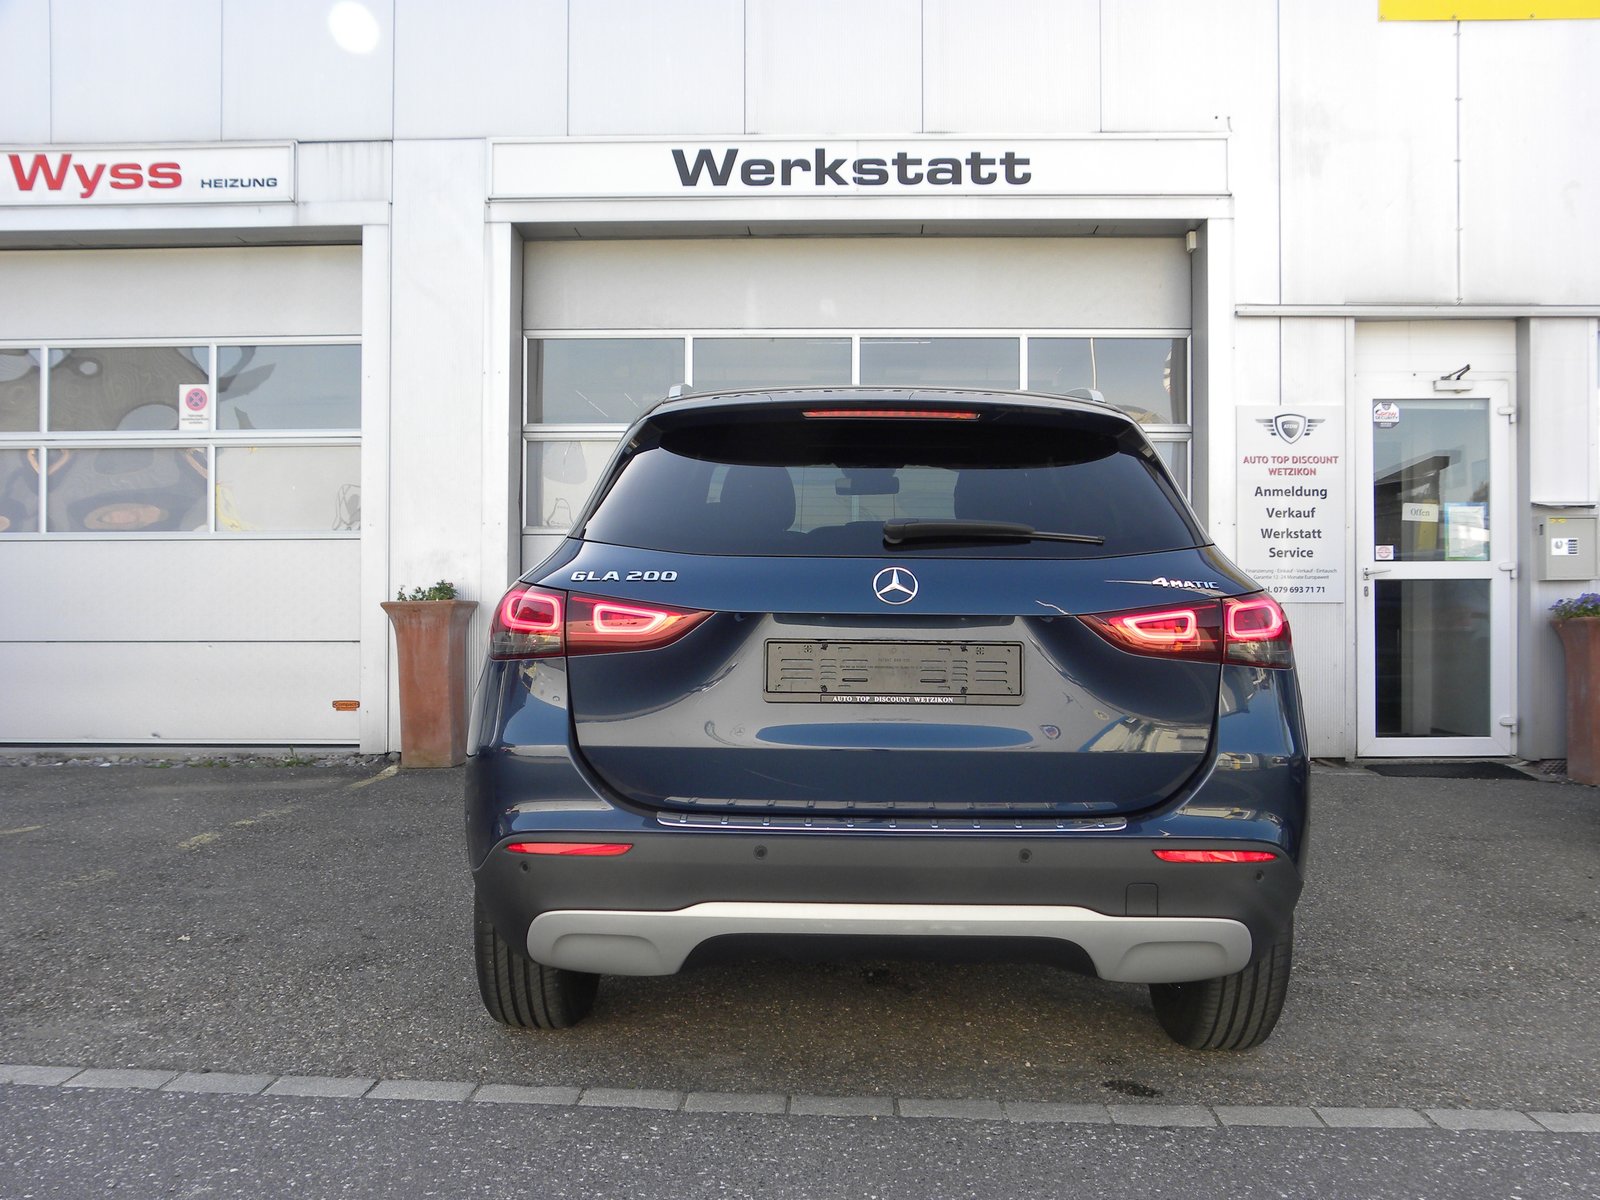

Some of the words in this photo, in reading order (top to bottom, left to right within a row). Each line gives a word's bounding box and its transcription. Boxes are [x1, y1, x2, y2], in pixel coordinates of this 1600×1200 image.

[671, 148, 1032, 187] Werkstatt
[8, 153, 183, 199] Wyss
[200, 178, 278, 189] HEIZUNG
[1243, 455, 1269, 464] AUTO
[1271, 455, 1290, 464] TOP
[1291, 455, 1339, 464] DISCOUNT
[1268, 467, 1317, 476] WETZIKON
[1254, 486, 1328, 500] Anmeldung
[1265, 507, 1316, 519] Verkauf
[1410, 507, 1430, 517] Offen
[1260, 528, 1322, 539] Werkstatt
[1268, 547, 1314, 558] Service
[570, 570, 620, 582] GLA
[625, 570, 678, 582] 200
[1151, 576, 1220, 589] 4MATIC
